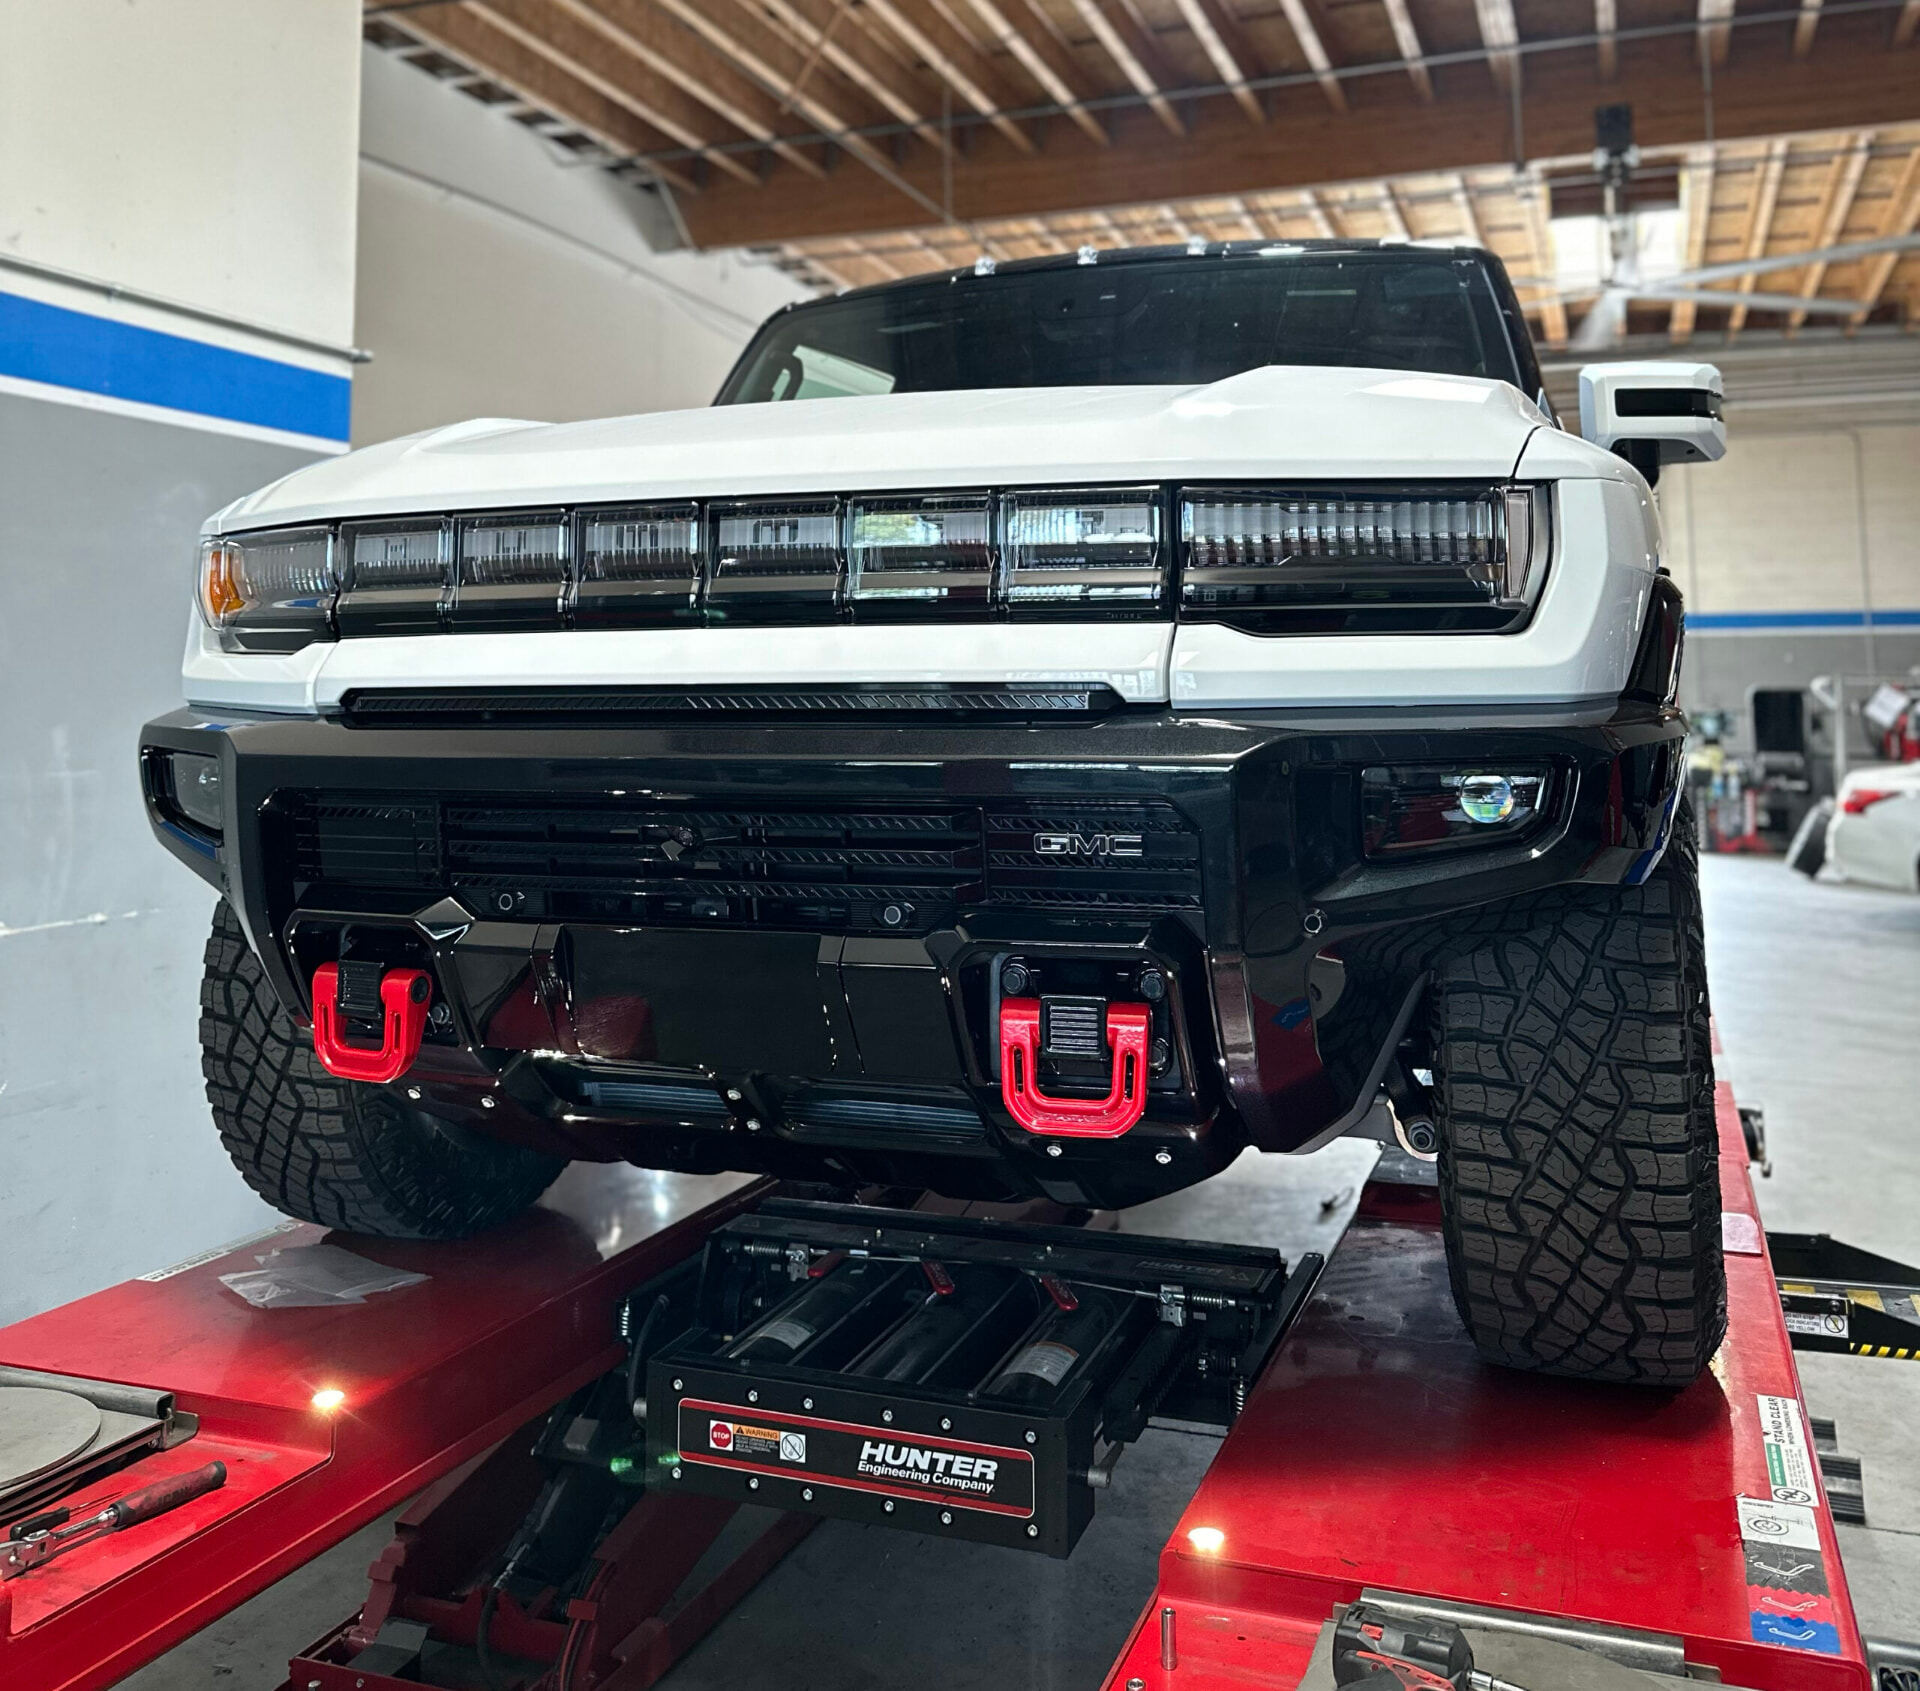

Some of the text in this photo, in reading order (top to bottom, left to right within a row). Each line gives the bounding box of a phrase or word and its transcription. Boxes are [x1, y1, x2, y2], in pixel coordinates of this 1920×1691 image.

[1033, 833, 1142, 856] GMC
[1767, 1397, 1781, 1419] CLEAR
[712, 1431, 730, 1440] STOP
[745, 1427, 778, 1439] WARNING
[1771, 1420, 1785, 1444] STAND
[860, 1440, 999, 1480] HUNTER
[857, 1460, 994, 1494] Engineering Company
